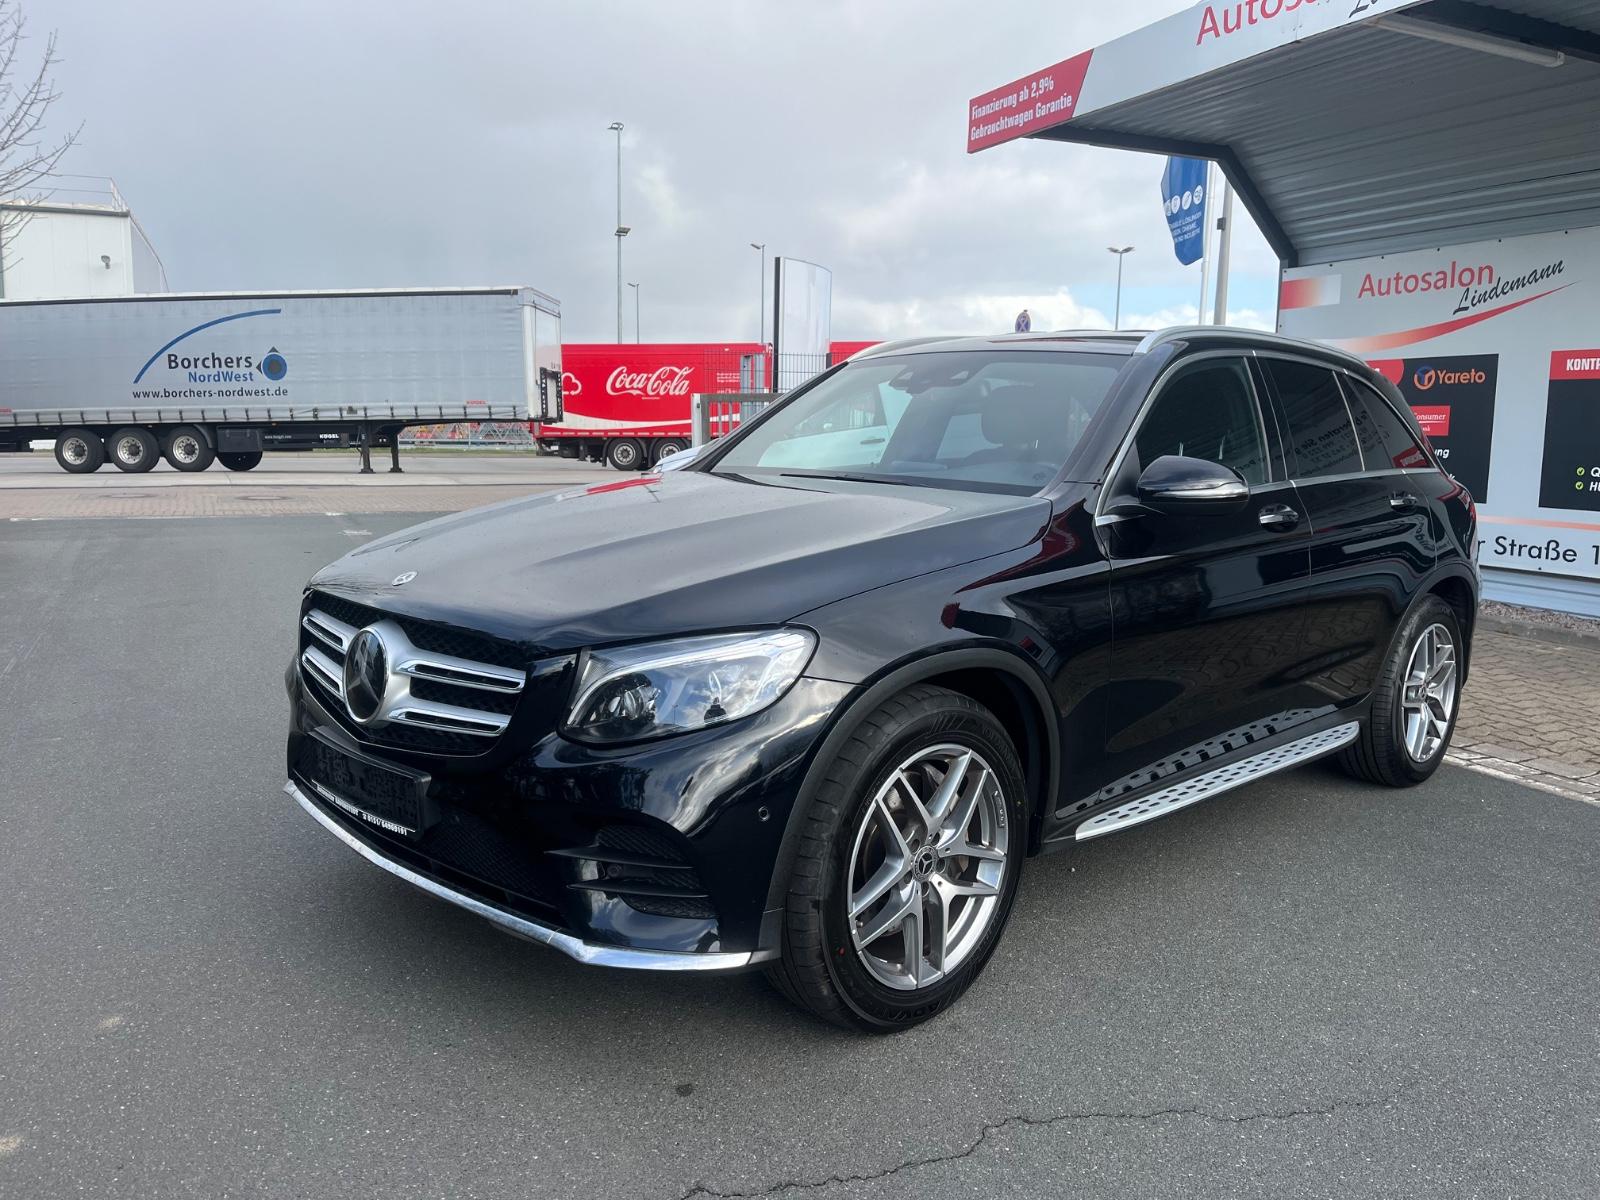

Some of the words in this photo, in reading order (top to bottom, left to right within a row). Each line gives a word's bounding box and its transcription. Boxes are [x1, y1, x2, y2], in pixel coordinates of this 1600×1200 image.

[1196, 0, 1316, 46] Auto
[971, 93, 1018, 121] Finanzierung
[1019, 86, 1029, 102] ab
[1030, 76, 1055, 99] 2,9%
[971, 109, 1034, 141] Gebrauchtwagen
[1035, 92, 1073, 118] Garantie
[1358, 260, 1495, 299] Autosalon
[1452, 259, 1565, 316] Lindemann
[167, 352, 253, 370] Borchers
[188, 370, 254, 383] NordWest
[605, 366, 696, 396] Coca-Cola
[1437, 368, 1486, 385] Yareto
[132, 386, 289, 399] www.borchers-nordwest.de
[1413, 412, 1447, 421] onsumer
[1590, 466, 1600, 478] Q
[1493, 535, 1578, 563] Straße
